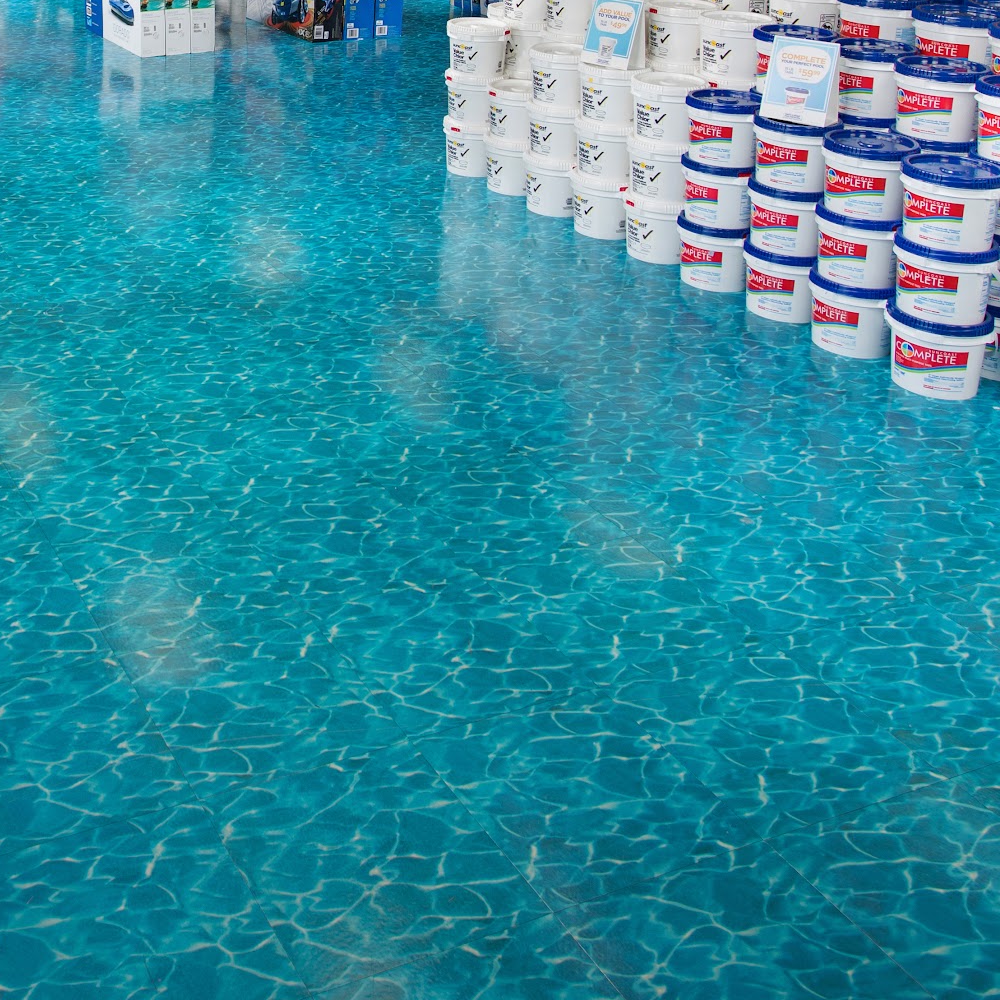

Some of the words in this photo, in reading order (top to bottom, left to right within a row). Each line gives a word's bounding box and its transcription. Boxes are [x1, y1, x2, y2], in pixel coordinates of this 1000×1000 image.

[599, 7, 612, 15] ADD
[613, 9, 633, 18] VALUE
[841, 23, 869, 37] MPLETE
[781, 52, 827, 64] COMPLETE
[839, 77, 862, 88] PLETE
